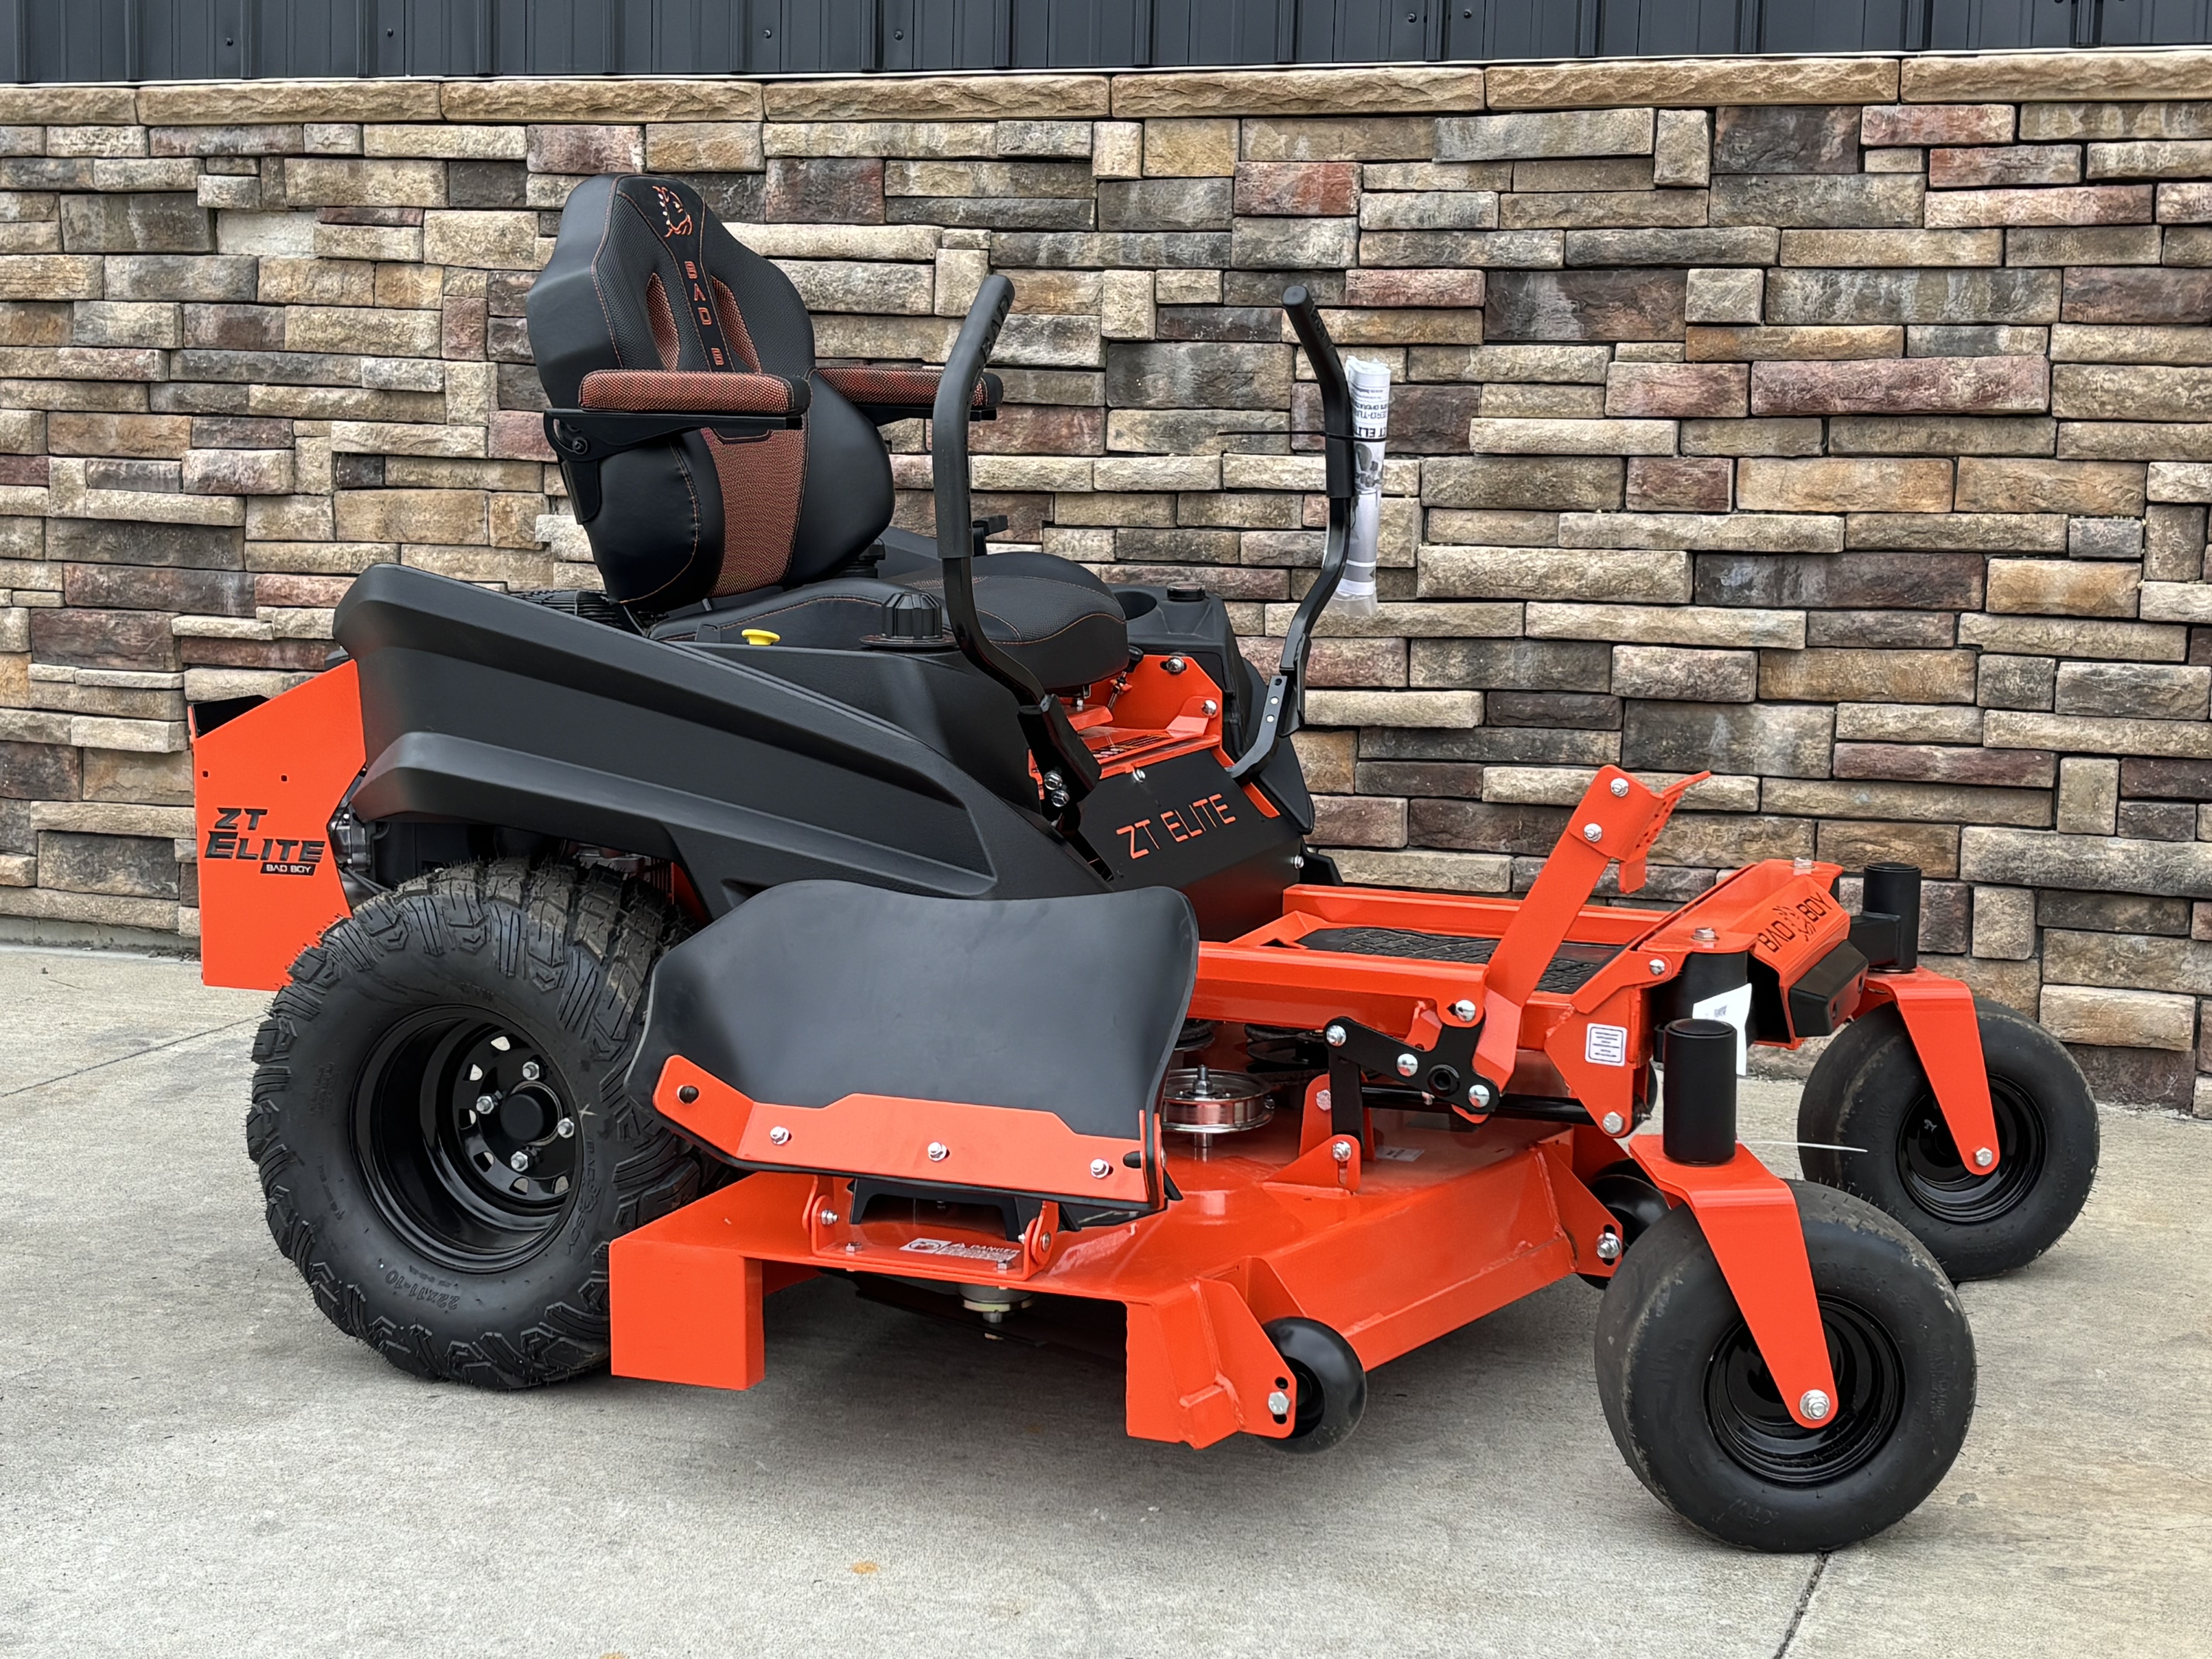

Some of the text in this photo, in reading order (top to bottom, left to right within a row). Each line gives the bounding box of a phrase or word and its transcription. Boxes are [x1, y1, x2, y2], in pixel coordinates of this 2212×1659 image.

[684, 260, 725, 366] BAD B
[215, 807, 268, 831] ZT
[1116, 793, 1237, 860] ZT ELITE
[204, 830, 326, 863] ELITE
[266, 864, 312, 874] BAD BOY
[1757, 891, 1833, 953] BAD BOY
